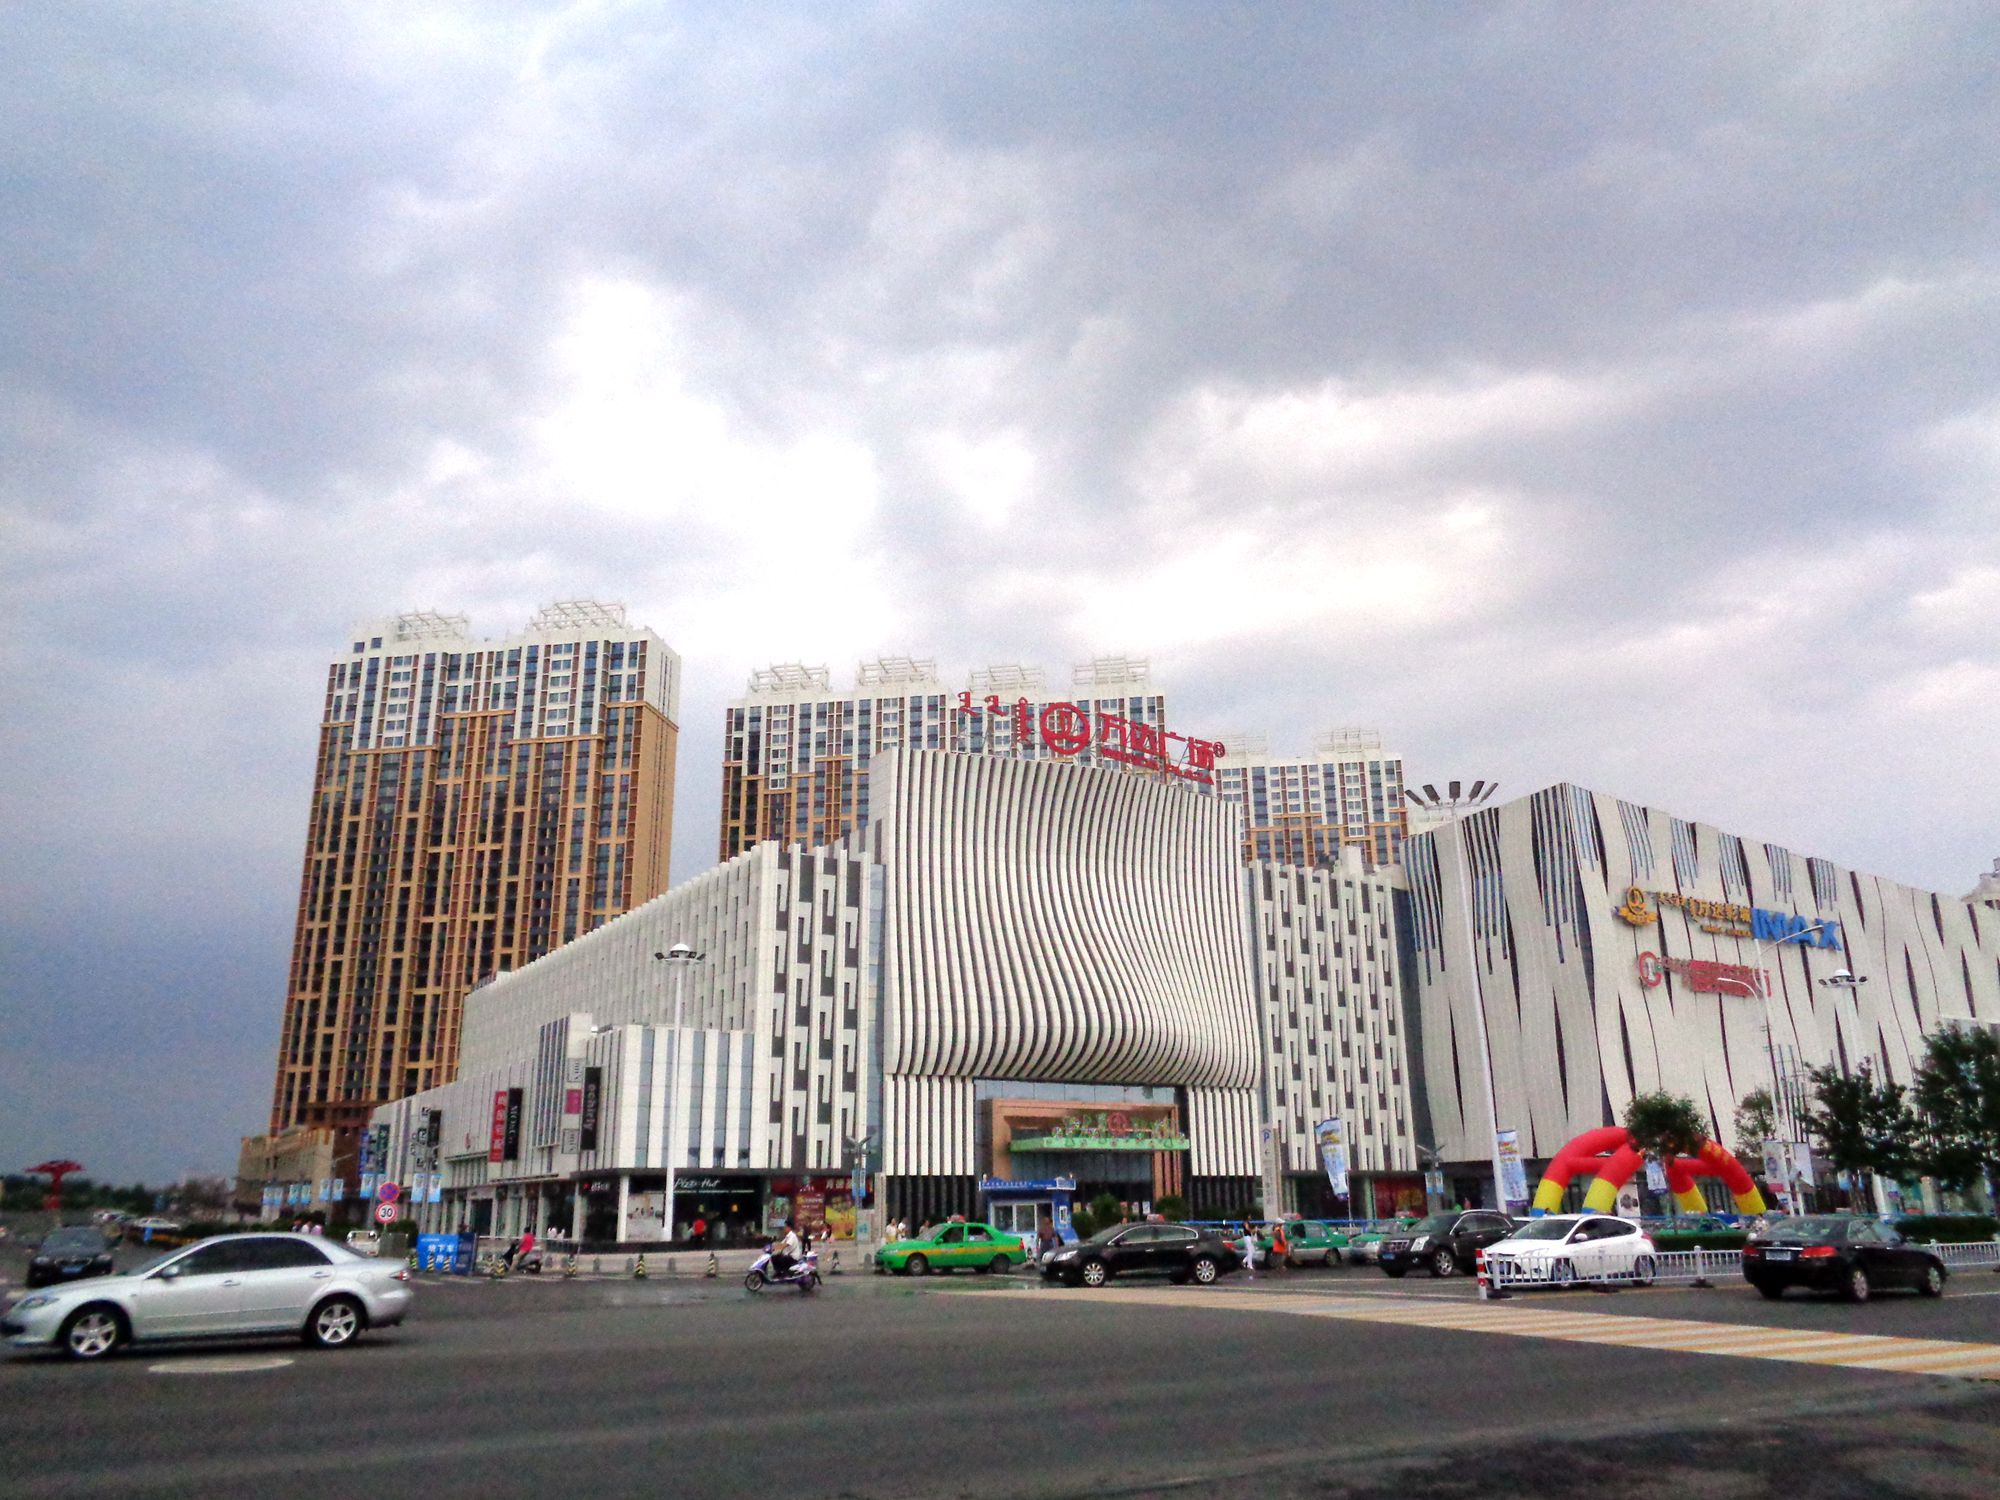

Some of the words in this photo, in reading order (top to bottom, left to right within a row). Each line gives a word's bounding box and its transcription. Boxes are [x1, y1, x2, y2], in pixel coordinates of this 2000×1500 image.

[1752, 908, 1842, 951] IMAX
[673, 1178, 697, 1190] Pizza
[701, 1178, 720, 1188] Hut
[380, 1208, 393, 1218] 30
